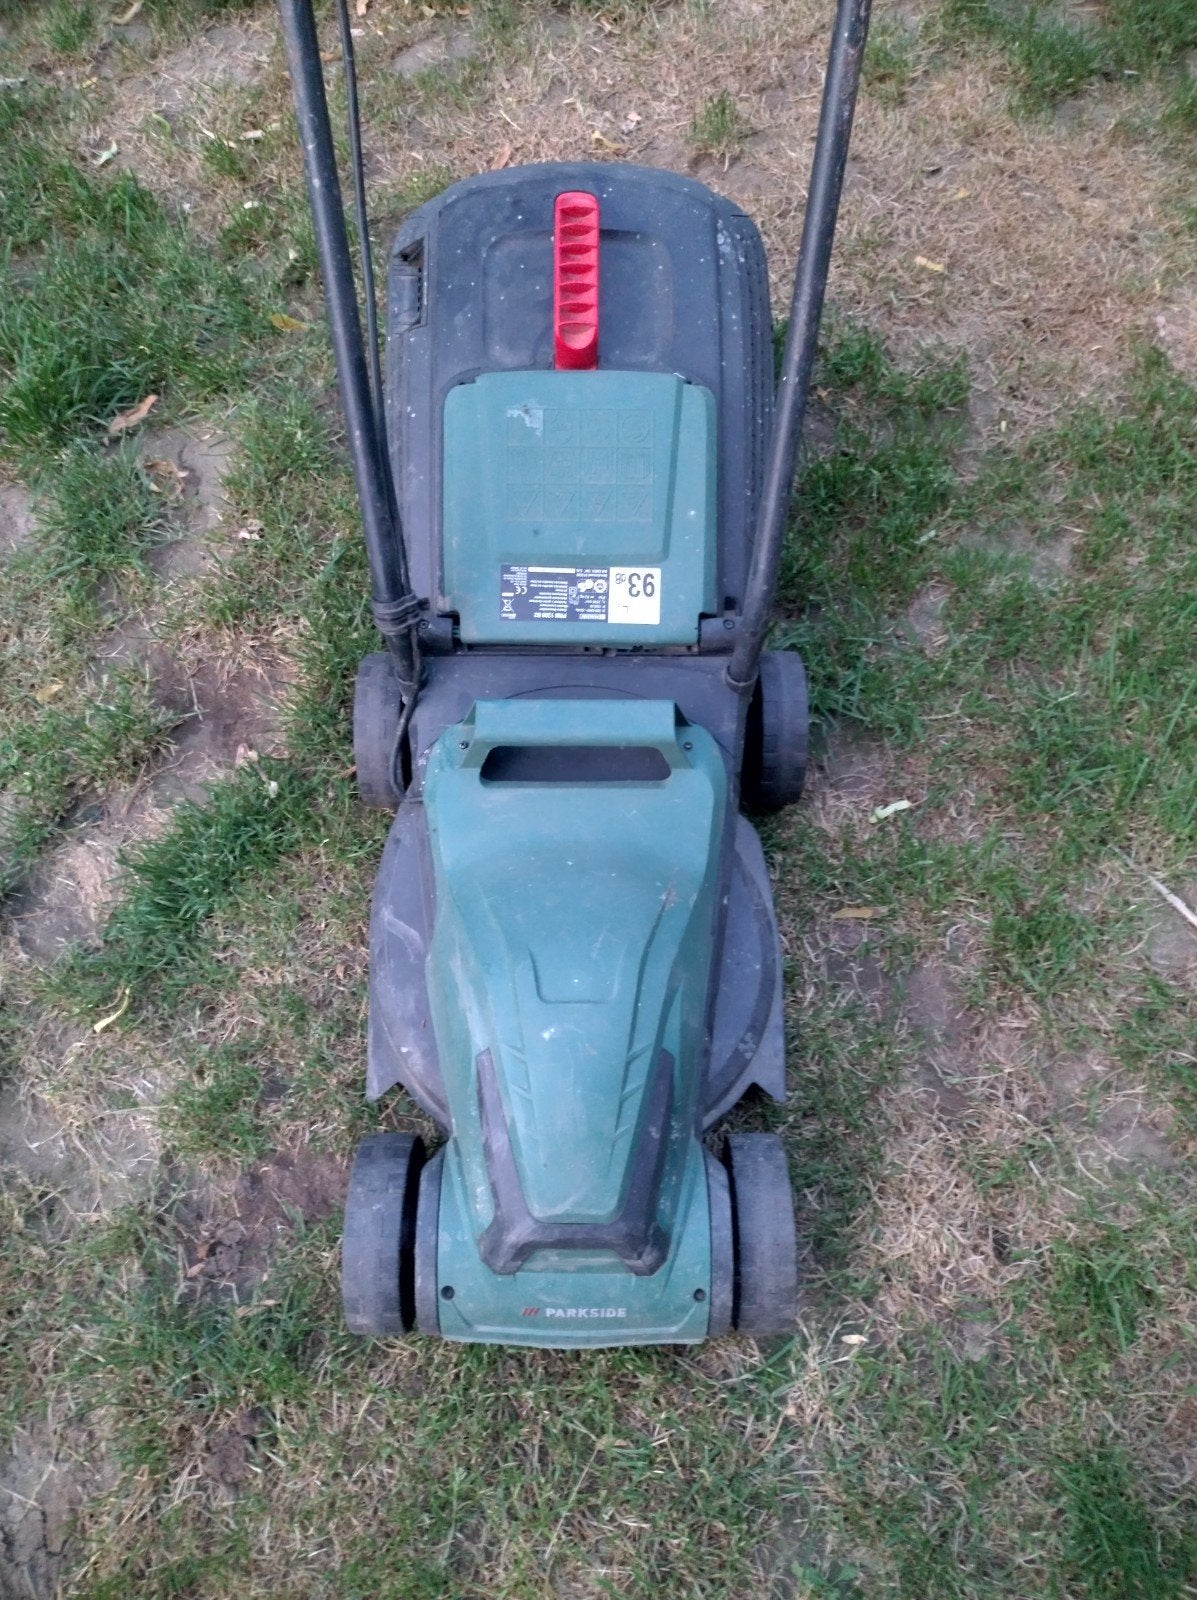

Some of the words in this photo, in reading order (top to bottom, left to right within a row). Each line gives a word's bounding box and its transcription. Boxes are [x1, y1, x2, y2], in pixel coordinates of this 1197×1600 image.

[615, 573, 627, 585] dB
[628, 573, 655, 598] 93
[545, 1307, 627, 1318] PARKSIDE
